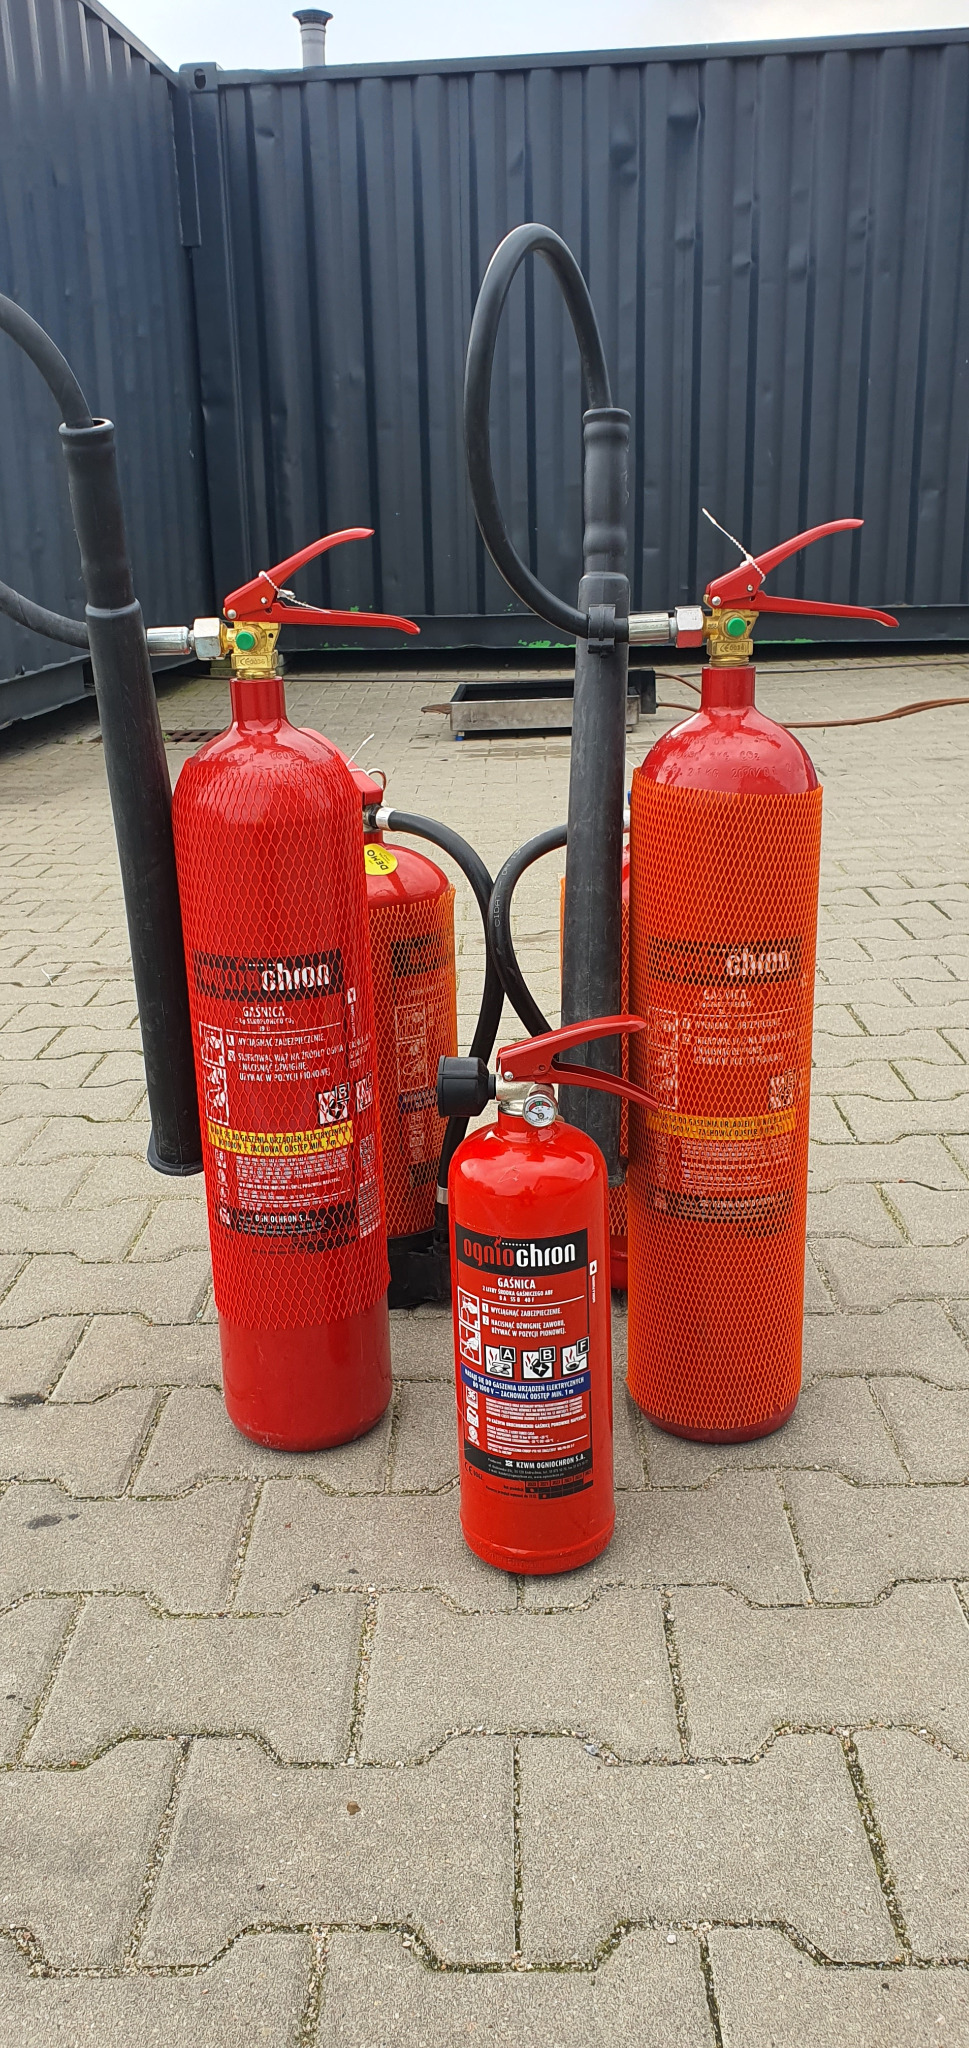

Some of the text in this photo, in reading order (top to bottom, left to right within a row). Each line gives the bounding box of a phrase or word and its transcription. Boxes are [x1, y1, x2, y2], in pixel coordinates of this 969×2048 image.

[366, 849, 389, 871] DEMO
[463, 1237, 576, 1268] ogniochron
[497, 1277, 536, 1289] GAŚNICA
[580, 1340, 587, 1351] F
[503, 1349, 513, 1359] A
[543, 1349, 552, 1359] B
[492, 1381, 517, 1391] GASZENIA
[546, 1376, 585, 1391] ELEKTRYCZNYCH
[500, 1390, 529, 1400] ZACHOWAĆ
[516, 1460, 535, 1469] KZWM
[536, 1456, 575, 1469] OGNIOCHRON
[575, 1453, 586, 1463] S.A.
